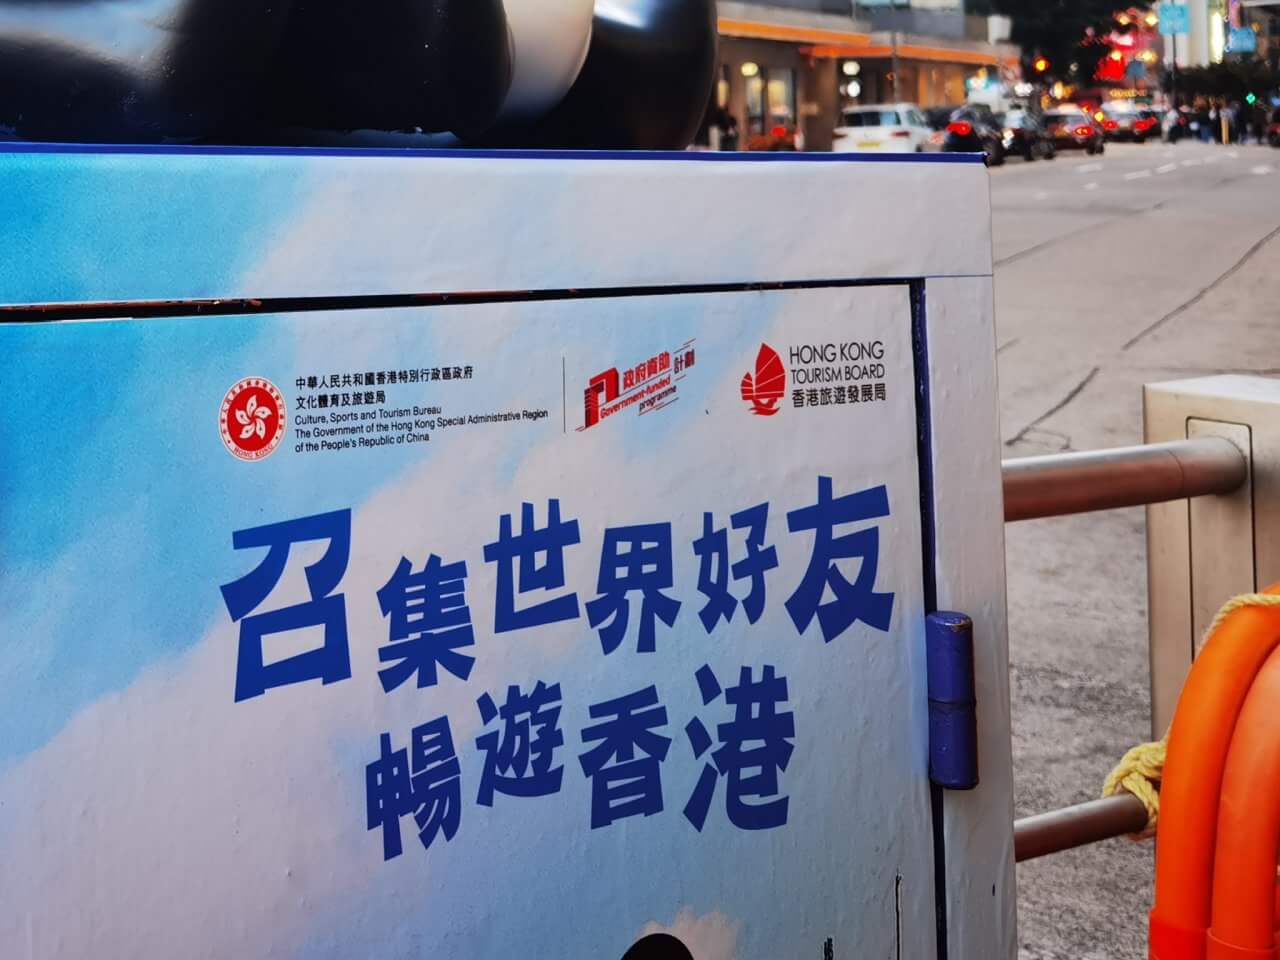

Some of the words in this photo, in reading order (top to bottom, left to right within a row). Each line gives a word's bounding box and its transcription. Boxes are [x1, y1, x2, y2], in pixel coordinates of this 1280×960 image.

[789, 343, 837, 365] HONG
[840, 341, 885, 361] KONG
[295, 365, 473, 391] 中華人民共和國香港特別行政區政府
[790, 365, 842, 385] TOURISM
[844, 363, 885, 381] BOARD
[295, 390, 386, 410] 文化體育及旅遊局
[600, 374, 671, 420] Government-funded
[639, 385, 677, 413] programme
[792, 383, 886, 408] 香港旅遊發展局
[294, 414, 329, 425] Culture,
[330, 412, 359, 424] Sports
[360, 410, 377, 420] and
[379, 407, 411, 418] Tourism
[413, 405, 442, 416] Bureau
[295, 428, 311, 439] The
[313, 425, 364, 438] Government
[366, 423, 375, 433] of
[376, 422, 389, 432] the
[391, 420, 413, 432] Hong
[414, 419, 435, 430] Kong
[437, 415, 466, 428] Special
[467, 410, 521, 425] Administrative
[522, 408, 549, 421] Region
[295, 442, 304, 453] of
[306, 441, 319, 452] the
[321, 437, 357, 450] People's
[359, 435, 395, 448] Republic
[396, 433, 405, 444] of
[406, 432, 430, 443] China
[220, 475, 896, 703] 召集世界好友
[365, 663, 796, 862] 暢遊香港
